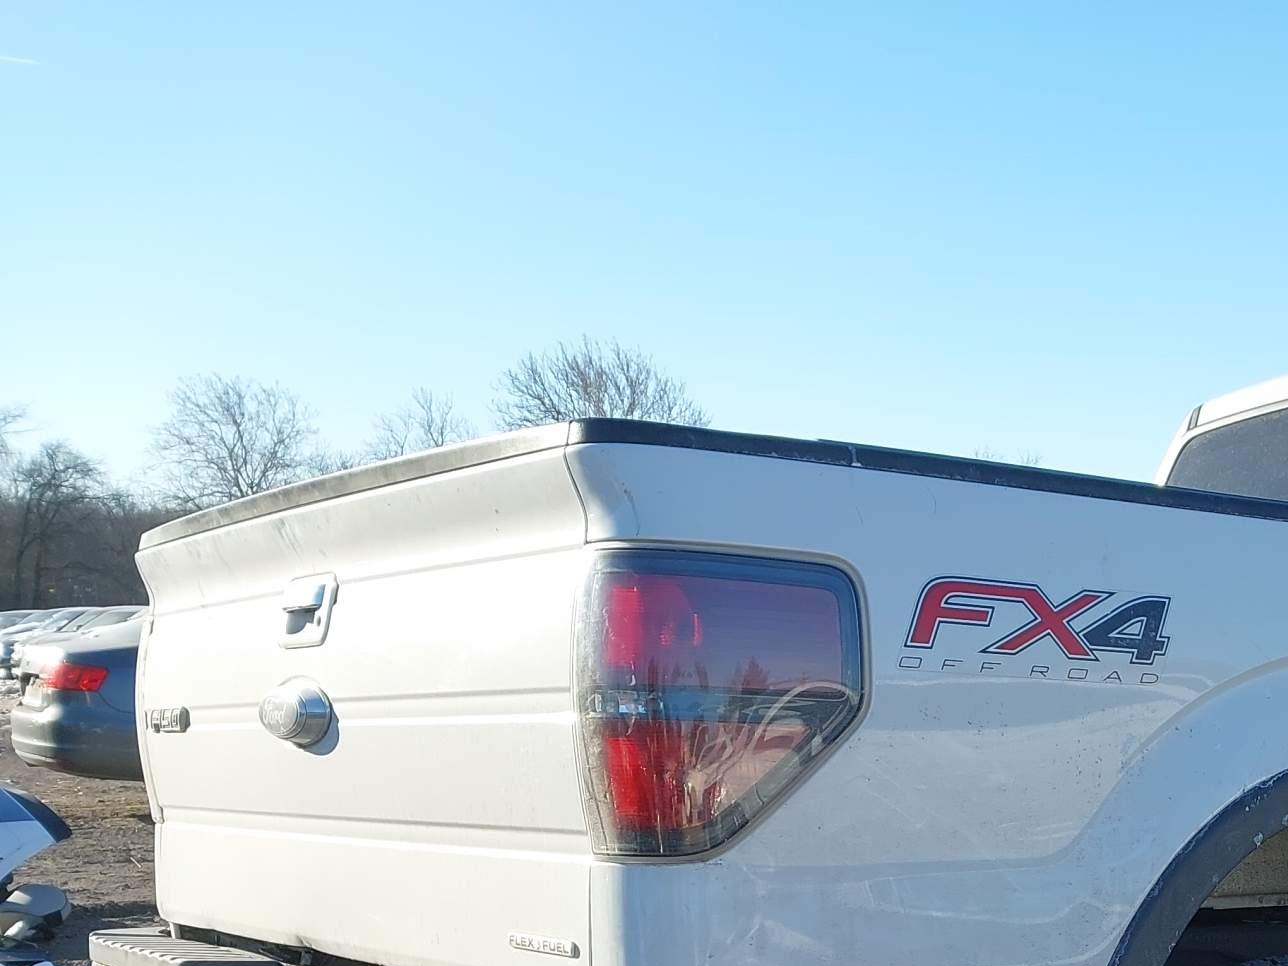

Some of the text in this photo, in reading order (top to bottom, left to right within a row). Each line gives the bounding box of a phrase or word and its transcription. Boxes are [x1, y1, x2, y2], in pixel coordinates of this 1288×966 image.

[903, 575, 1172, 665] FX4
[898, 656, 1160, 684] OFF ROAD
[509, 935, 569, 955] FLEX FUEL
